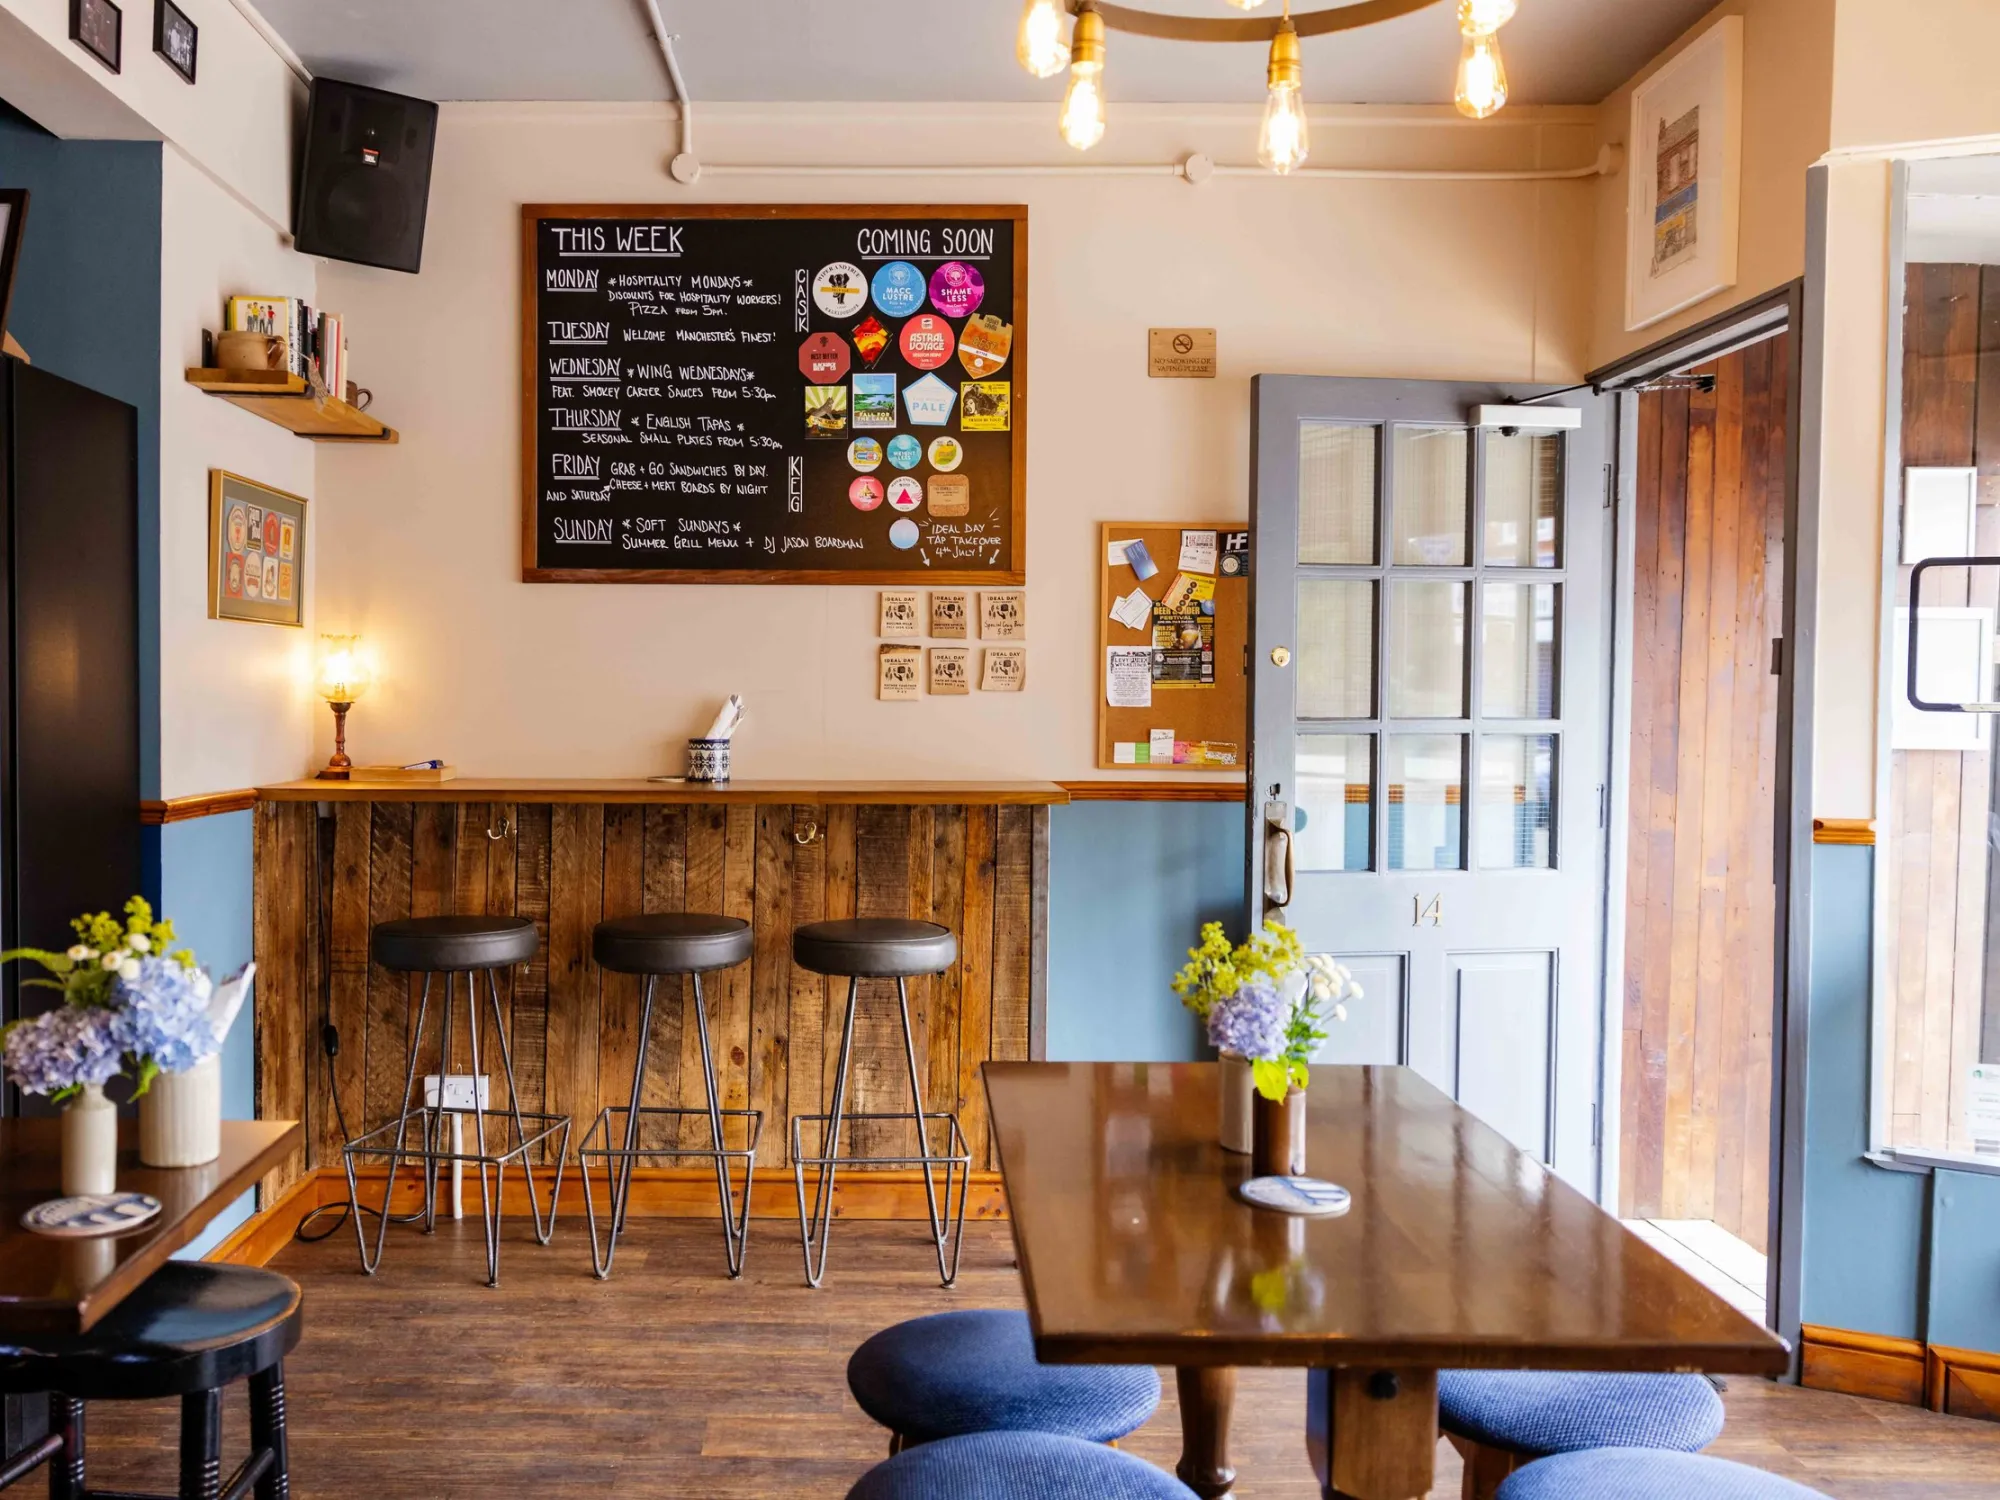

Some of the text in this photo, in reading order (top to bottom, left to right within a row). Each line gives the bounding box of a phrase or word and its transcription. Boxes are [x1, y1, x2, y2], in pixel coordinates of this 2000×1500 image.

[551, 226, 684, 252] THIS WEEK
[857, 228, 994, 255] COMING SOON
[546, 269, 599, 289] MONDAY
[607, 290, 781, 305] DISCOUNTS FOR HOSPITALITY WORKERS!
[882, 293, 914, 302] LUSTRE
[941, 287, 973, 296] SHAME
[947, 295, 968, 303] LESS
[797, 269, 808, 332] CASK
[628, 302, 669, 316] PIZZA
[675, 307, 698, 316] FROM
[547, 321, 776, 343] TUESDAY WELCOME MANCHESTER'S FINEST!
[910, 332, 944, 342] ASTRAL
[909, 342, 945, 351] VOYAGE
[549, 357, 622, 376] WEDNESDAY
[637, 364, 673, 380] WING
[552, 385, 575, 399] FEAT.
[583, 385, 621, 400] SMOKEY
[626, 386, 662, 398] CARTER
[668, 385, 704, 398] SAUCES
[712, 387, 737, 399] FROM
[912, 402, 946, 412] PALE
[548, 408, 732, 432] THURSDAY ENGLISH TAPAS
[582, 432, 633, 445] SEASONAL
[640, 431, 672, 445] SMALL
[677, 434, 713, 446] PLATES
[717, 436, 744, 448] FROM
[552, 454, 601, 476] FRIDAY
[610, 462, 637, 477] GRAB
[640, 465, 646, 474] +
[648, 462, 664, 476] GO
[669, 463, 728, 477] SANDWICHES
[734, 464, 746, 478] BY
[609, 478, 643, 491] CHEESE
[651, 481, 676, 492] MEAT
[681, 481, 716, 494] BOARDS
[719, 482, 732, 495] BY
[736, 483, 768, 496] NIGHT
[790, 456, 801, 512] KEG
[546, 489, 611, 503] AND SATURDAY
[553, 517, 730, 541] SUNDAY SOFT SUNDAYS
[931, 523, 986, 534] IDEAL DAY
[622, 534, 864, 554] SUMMER GRILL MENU + DJ JASON BOARDMAN
[926, 535, 1002, 546] TAP TAKEOVER
[935, 545, 952, 556] 4th
[1153, 606, 1171, 615] BEER
[1412, 892, 1443, 927] 14
